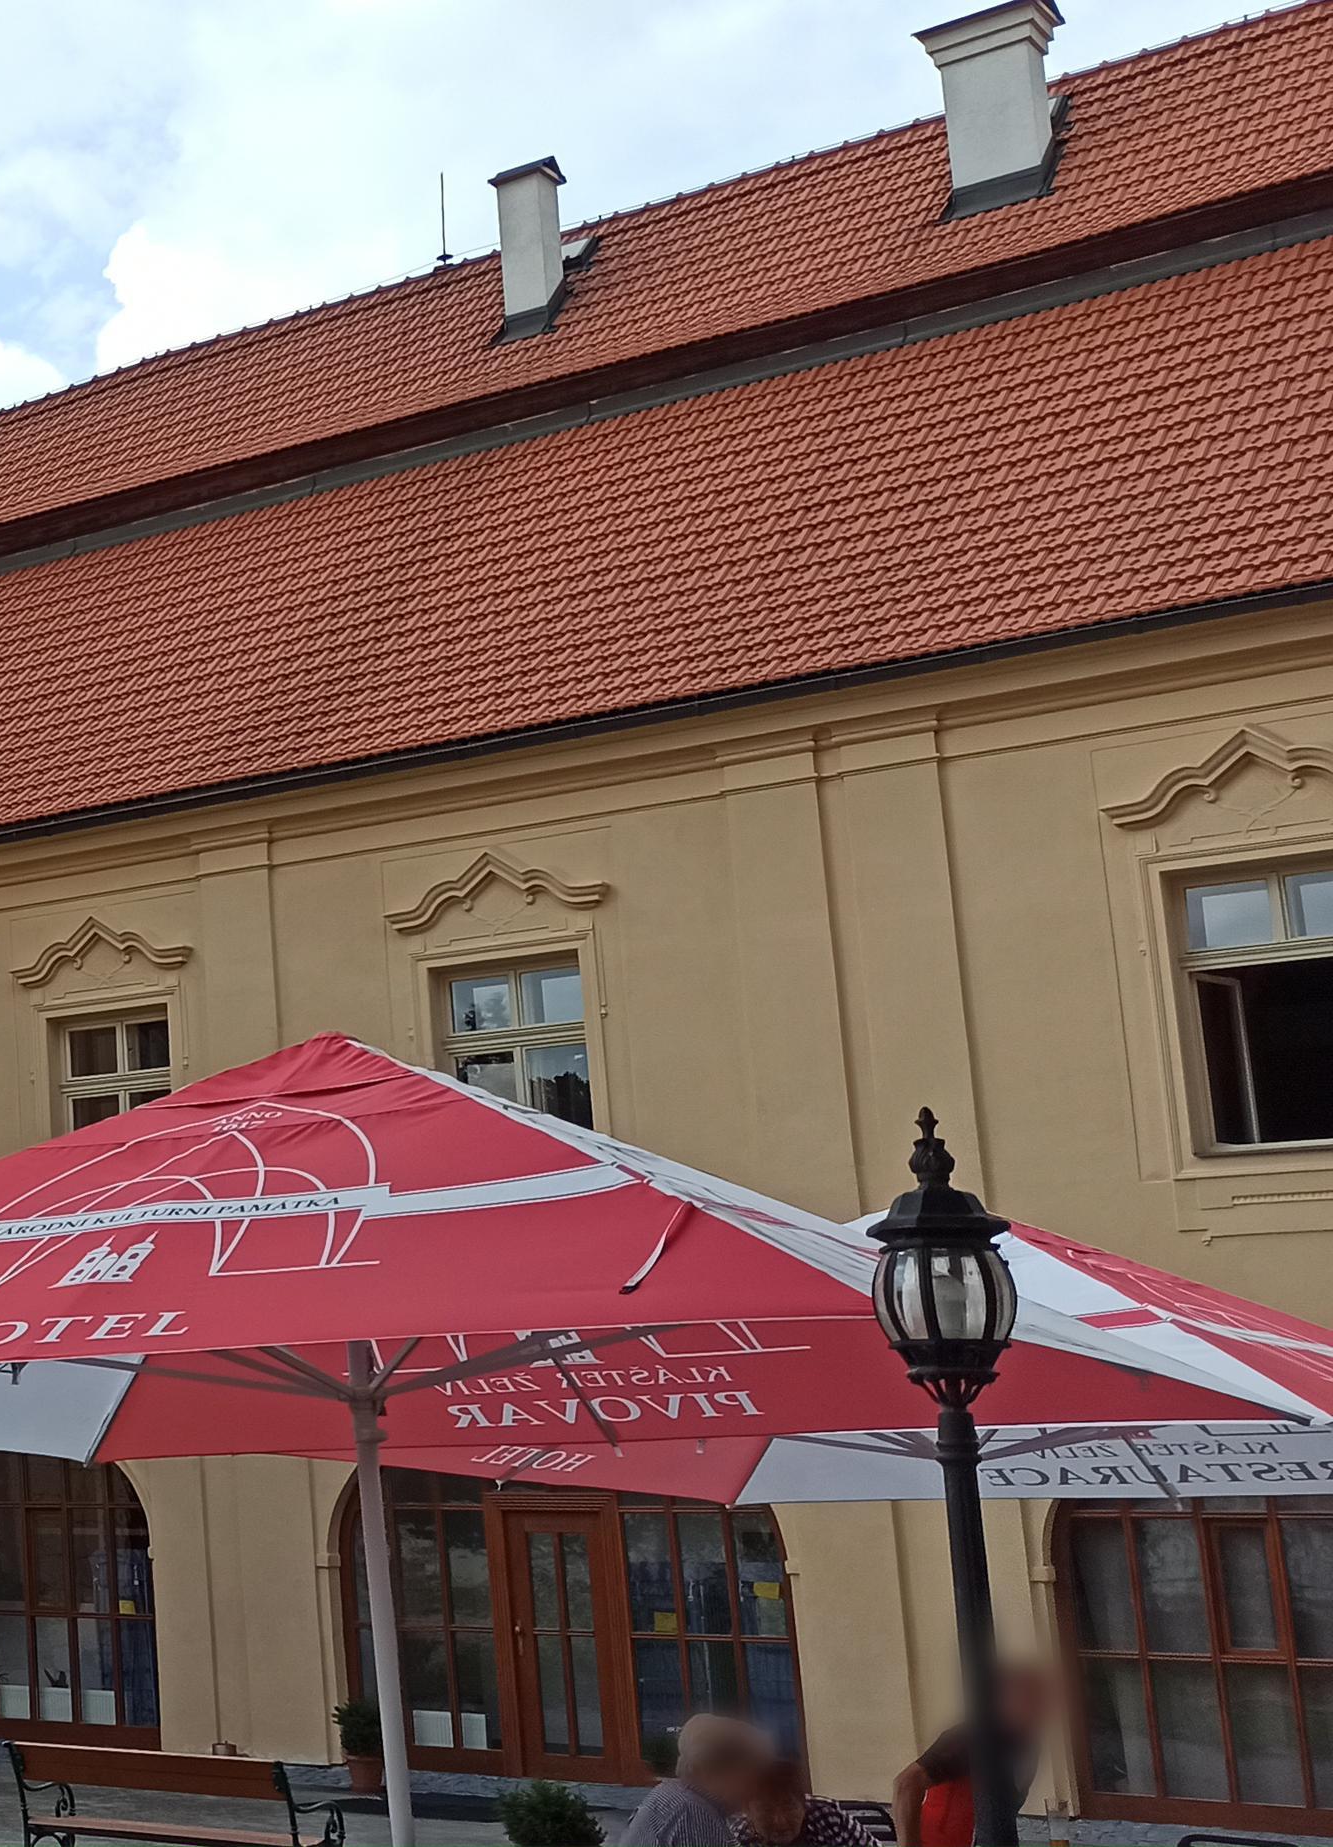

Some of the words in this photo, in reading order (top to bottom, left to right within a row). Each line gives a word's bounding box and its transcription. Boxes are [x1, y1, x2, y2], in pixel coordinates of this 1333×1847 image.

[212, 1111, 282, 1126] ANNO
[91, 1205, 215, 1225] KULTURNÍ
[217, 1197, 340, 1214] PAMÁTKA
